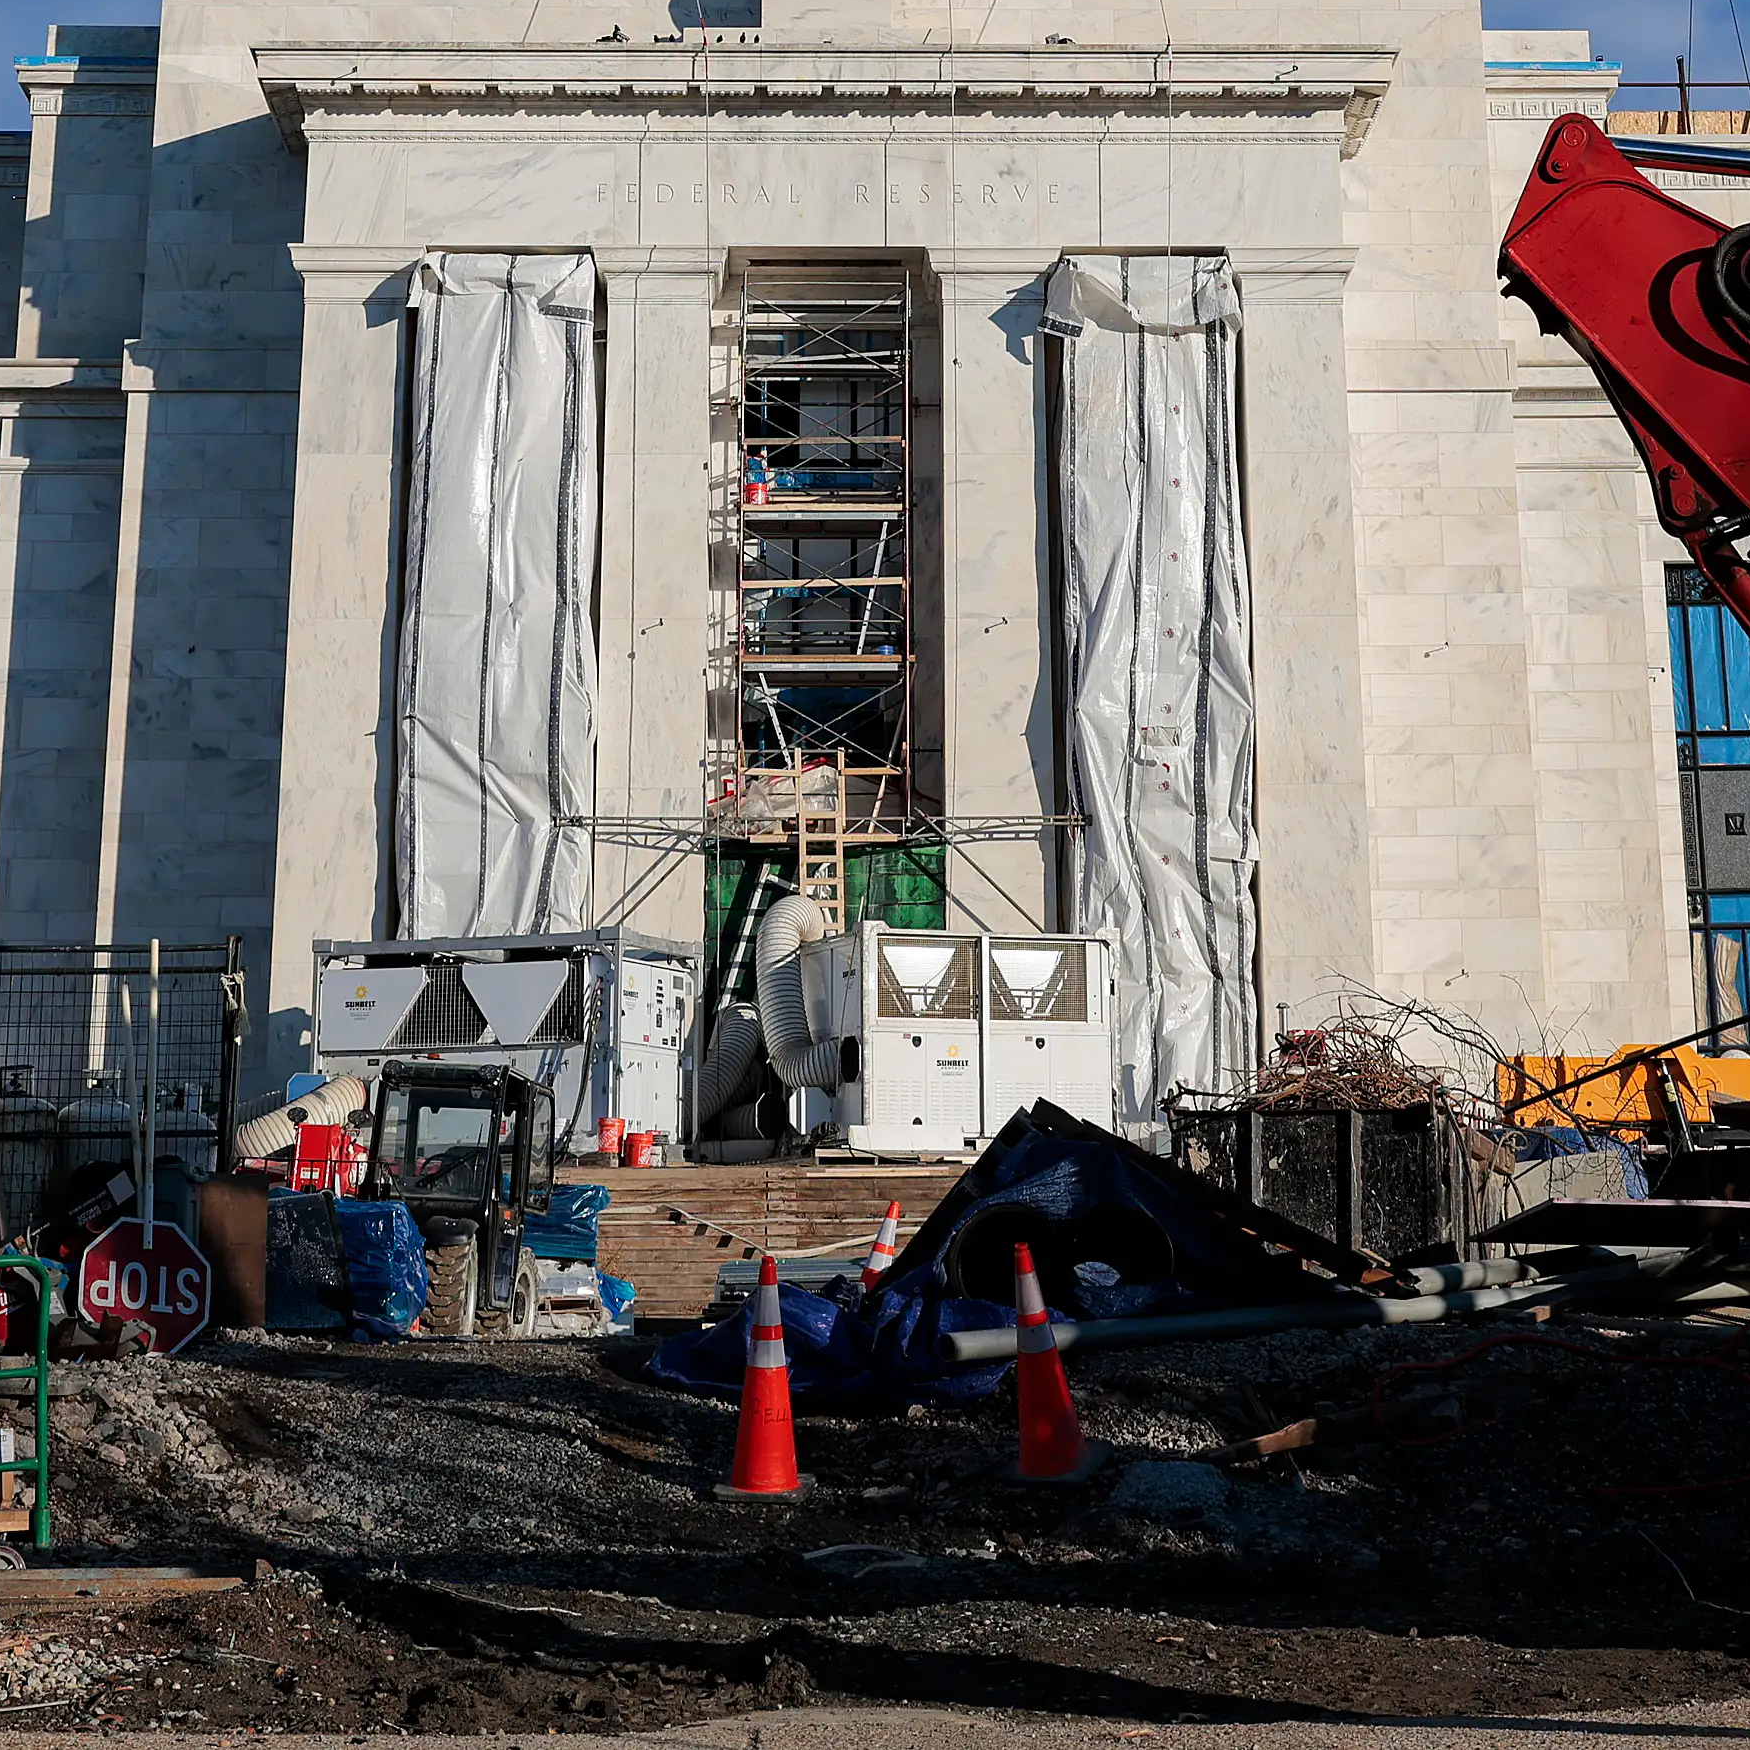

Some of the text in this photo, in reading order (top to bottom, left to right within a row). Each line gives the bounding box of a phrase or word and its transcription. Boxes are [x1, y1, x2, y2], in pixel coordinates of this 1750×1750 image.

[595, 183, 1060, 204] FEDERAL RESERVE
[345, 1000, 376, 1008] SUNBELT
[936, 1059, 969, 1067] SUNBELT
[89, 1260, 200, 1316] STOP
